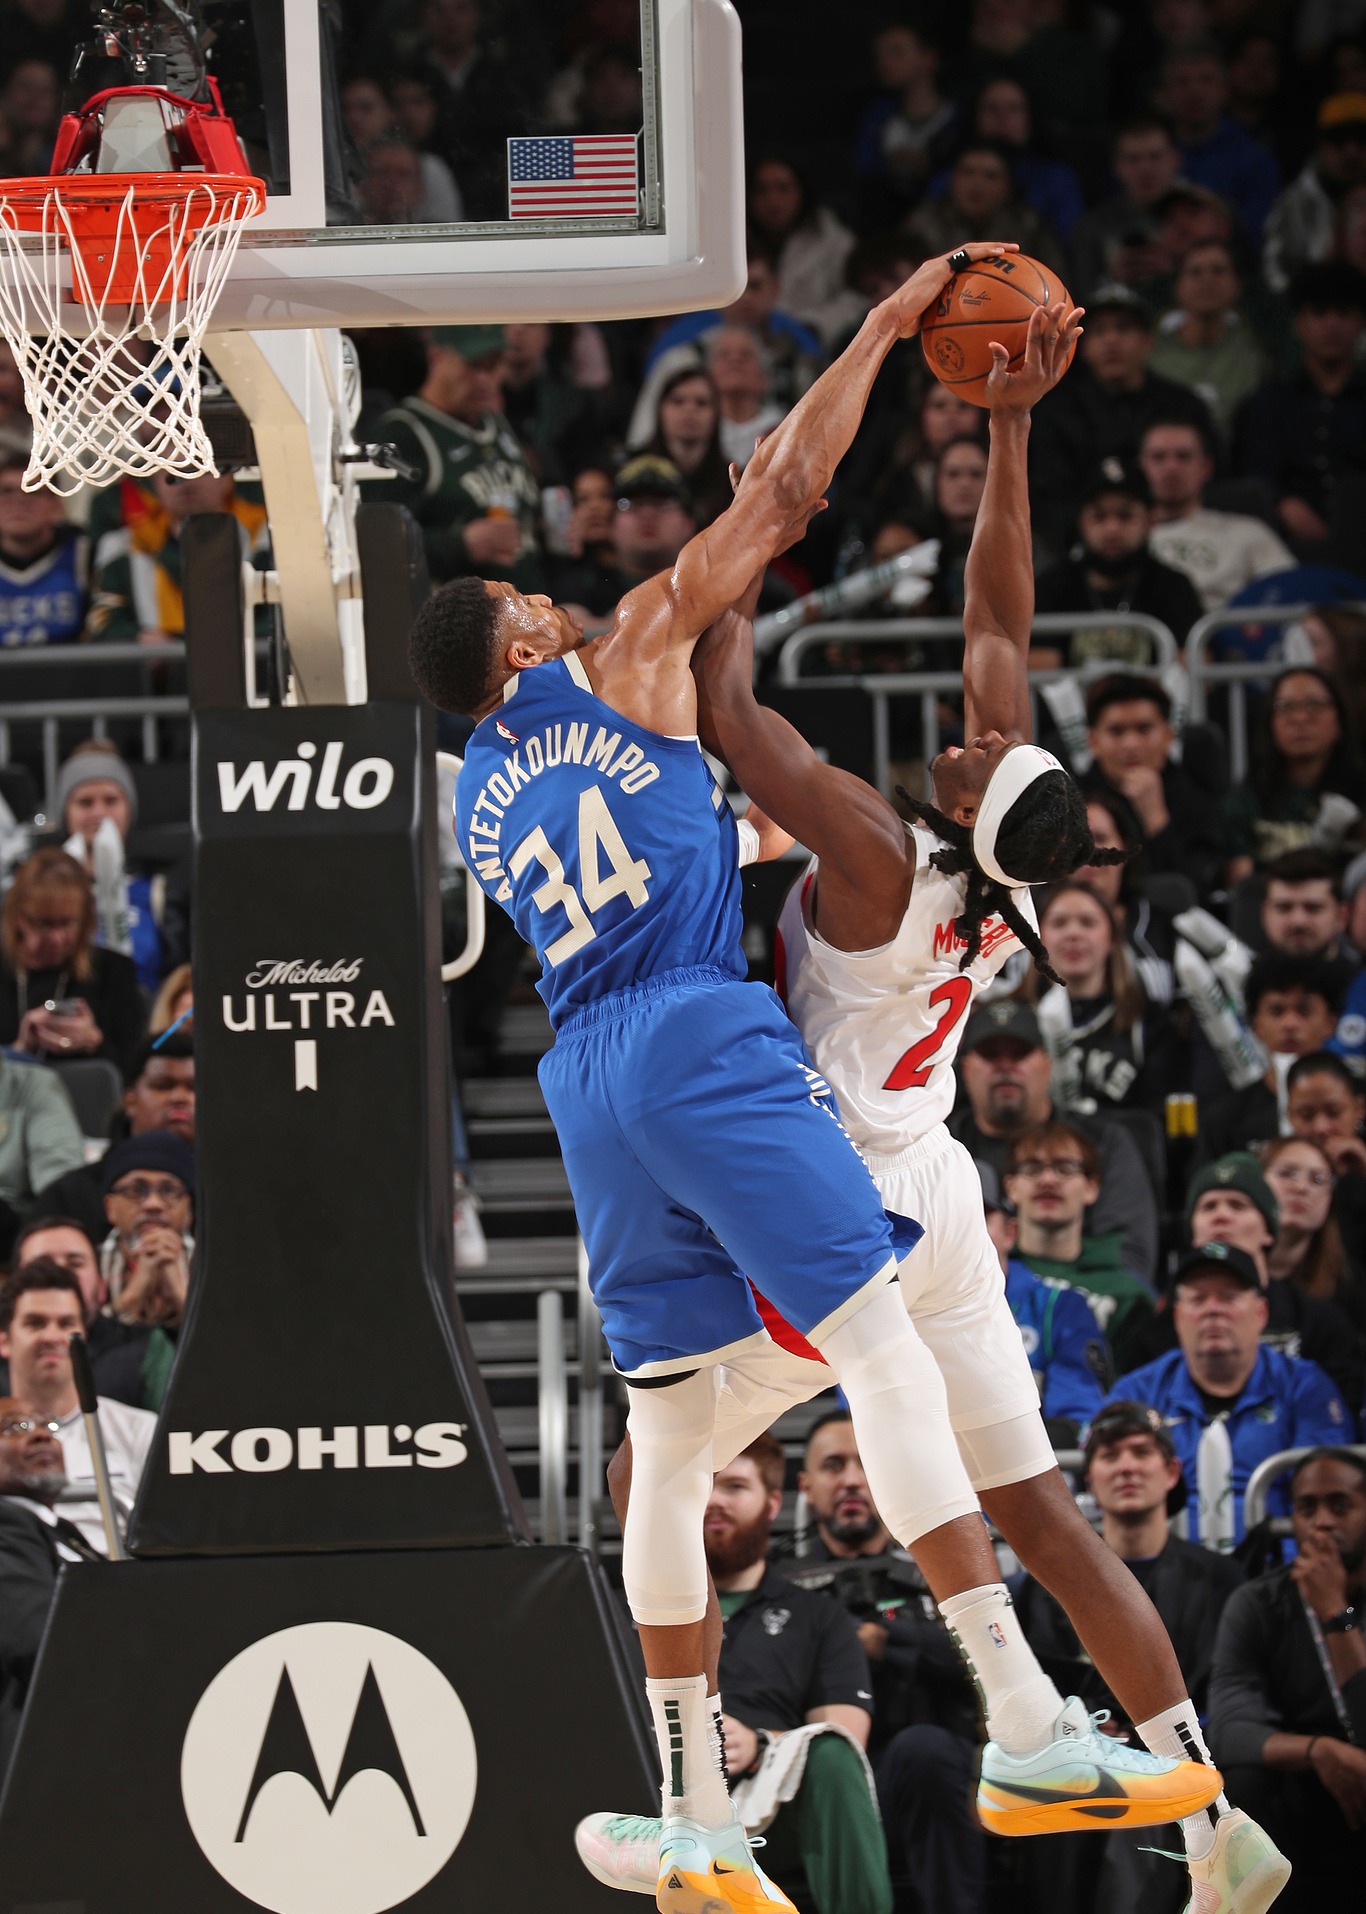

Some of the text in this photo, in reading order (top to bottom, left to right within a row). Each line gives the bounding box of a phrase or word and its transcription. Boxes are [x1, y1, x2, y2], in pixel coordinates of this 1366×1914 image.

[217, 741, 395, 813] wilo
[468, 721, 661, 902] ANTETOKOUNMPO
[508, 784, 652, 968] 34
[245, 957, 365, 989] Michelob
[222, 989, 396, 1033] ULTRA
[881, 976, 973, 1091] 2
[168, 1422, 468, 1475] KOHL'S
